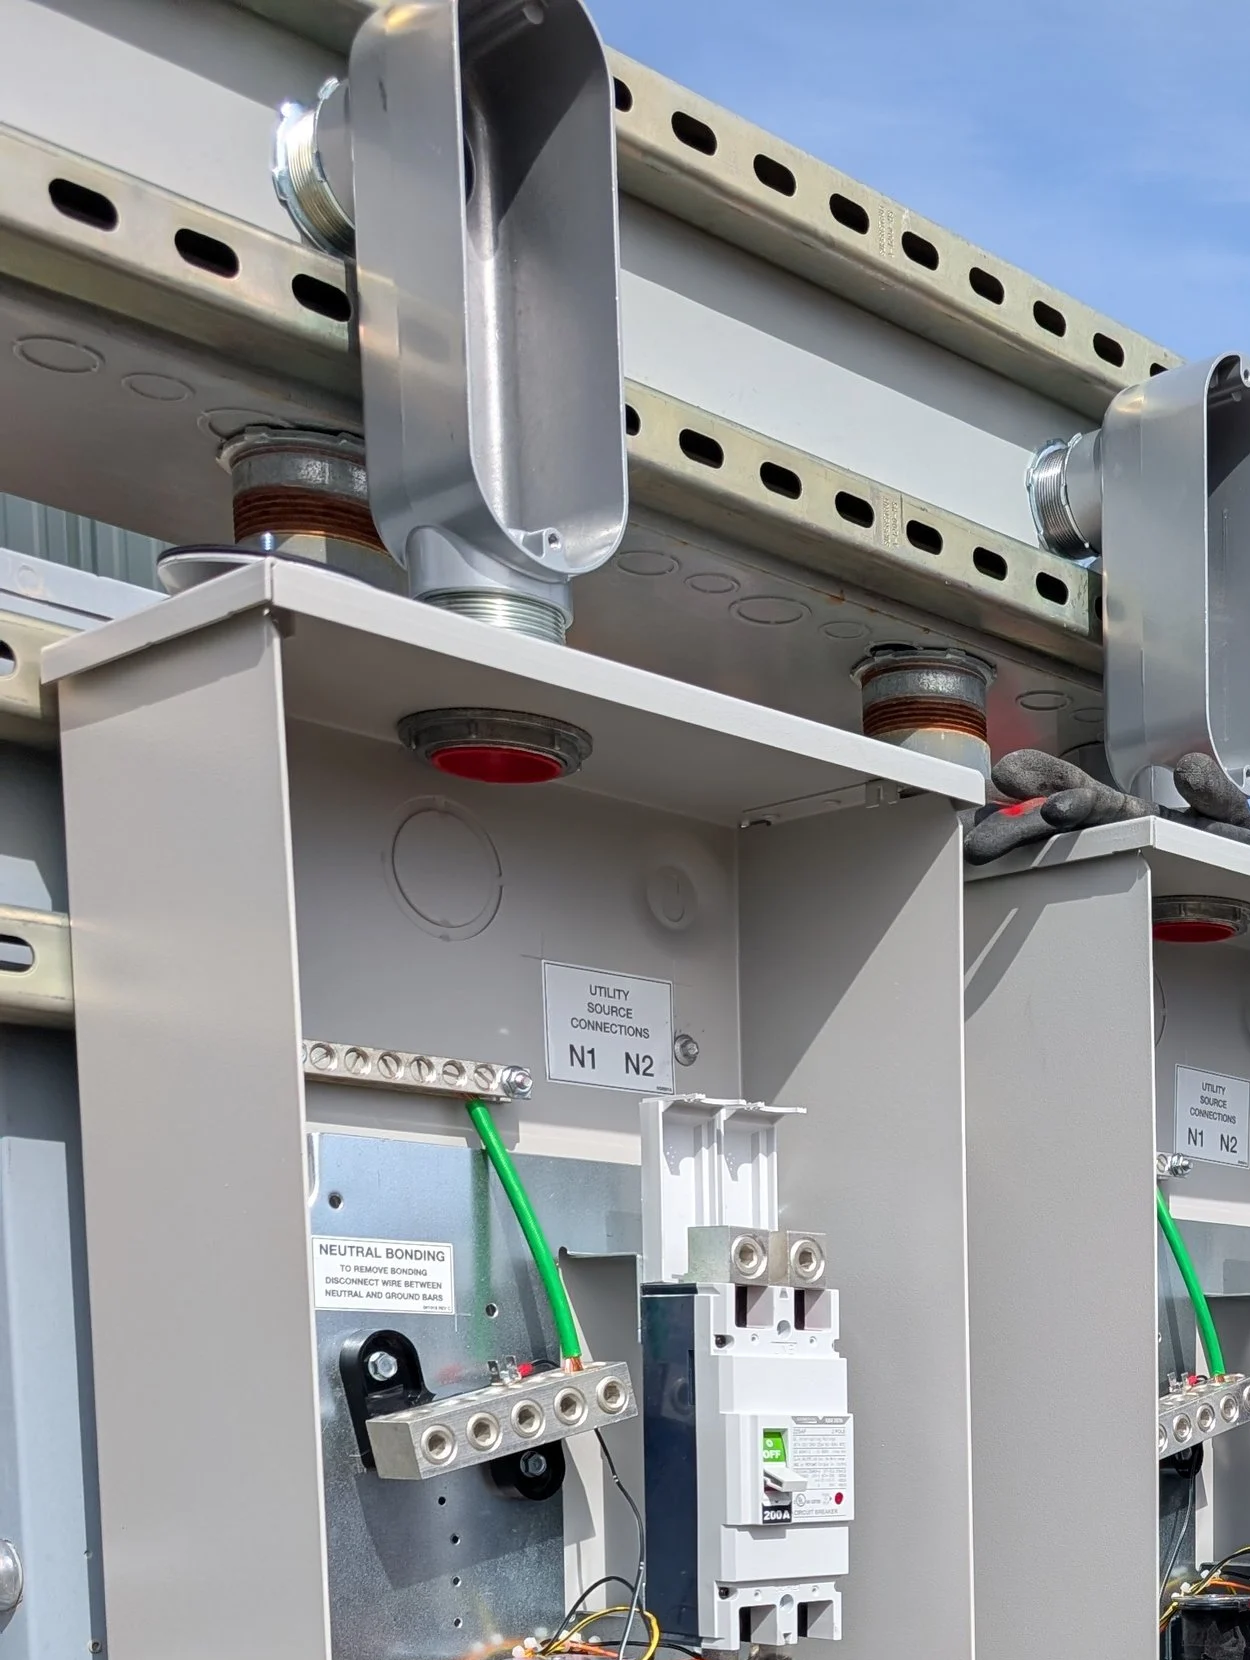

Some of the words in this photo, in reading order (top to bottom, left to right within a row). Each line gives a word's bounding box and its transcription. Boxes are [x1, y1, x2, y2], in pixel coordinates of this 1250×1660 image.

[589, 984, 630, 1001] UTILITY
[587, 1002, 633, 1019] SOURCE
[570, 1017, 650, 1039] CONNECTIONS
[569, 1044, 595, 1069] N1
[625, 1052, 654, 1077] N2
[1201, 1082, 1226, 1095] UTILITY
[1200, 1095, 1227, 1109] SOURCE
[1189, 1107, 1236, 1124] CONNECTIONS
[1188, 1127, 1203, 1147] N1
[1220, 1133, 1237, 1153] N2
[319, 1244, 381, 1258] NEUTRAL
[386, 1248, 445, 1262] BONDING
[340, 1264, 351, 1272] TO
[353, 1265, 388, 1274] REMOVE
[390, 1267, 427, 1276] BONDING
[325, 1277, 379, 1287] DISCONNECT
[381, 1279, 402, 1288] WIRE
[404, 1280, 442, 1289] BETWEEN
[325, 1289, 363, 1298] NEUTRAL
[366, 1291, 383, 1299] AND
[385, 1292, 420, 1301] GROUND
[422, 1293, 443, 1301] BARS
[763, 1450, 781, 1459] OFF
[763, 1510, 790, 1520] 200A
